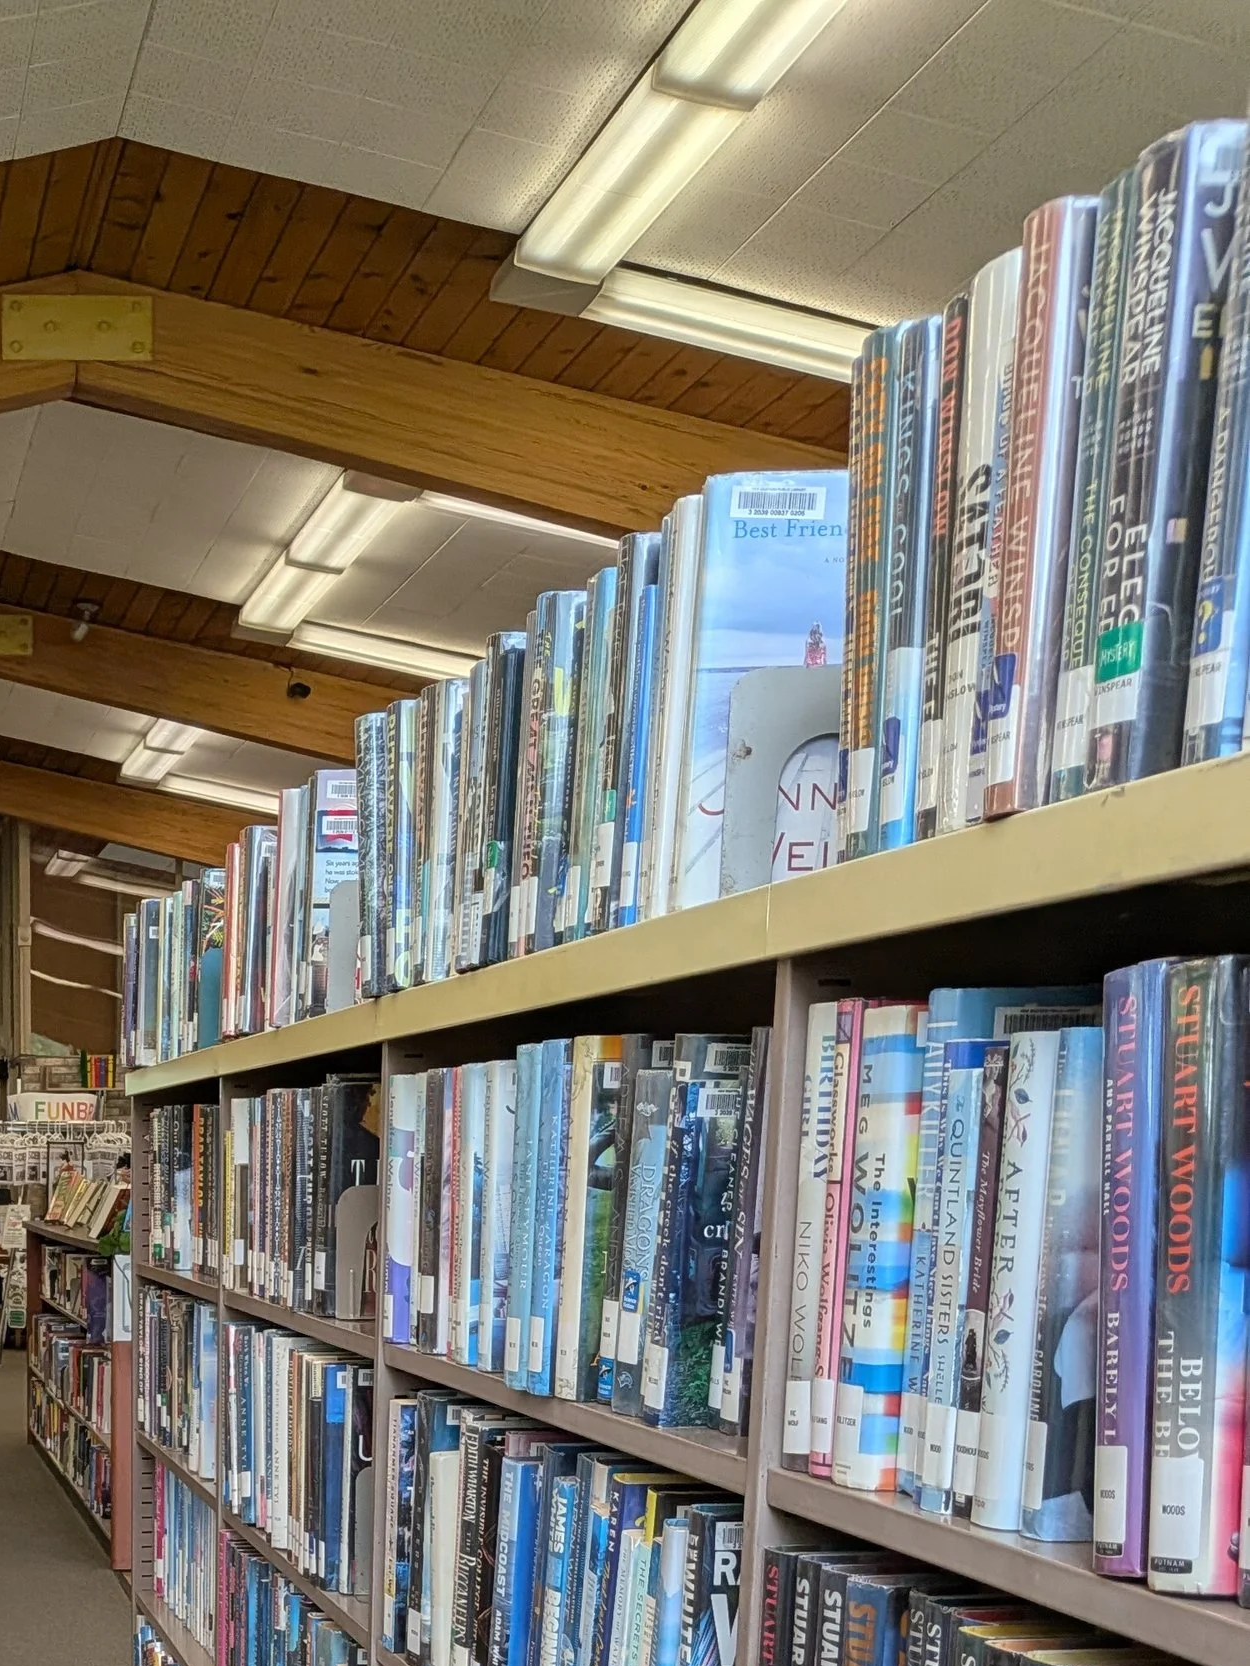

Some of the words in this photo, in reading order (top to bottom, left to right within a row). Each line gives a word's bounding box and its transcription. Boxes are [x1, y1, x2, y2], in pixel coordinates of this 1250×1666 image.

[1121, 191, 1158, 385] WINSPEAR
[1140, 188, 1178, 378] JACQUELINE
[1011, 243, 1049, 505] JACQUELINE
[734, 519, 777, 538] Best
[1104, 493, 1126, 578] FOR
[1115, 995, 1138, 1138] STUART
[1173, 984, 1200, 1134] STUART
[813, 1036, 836, 1178] BIRTHDAY
[827, 1051, 845, 1174] Glassworks
[859, 1064, 874, 1135] MEG
[873, 1153, 886, 1191] The
[941, 1119, 965, 1265] QUINTLAND
[980, 1152, 990, 1176] The
[1103, 1180, 1111, 1216] HALL
[637, 1164, 656, 1282] DRAGONS
[795, 1221, 813, 1290] NIKO
[976, 1181, 988, 1254] Mayflower
[997, 1160, 1023, 1274] AFTER
[1110, 1147, 1135, 1291] WOODS
[1167, 1146, 1196, 1294] WOODS
[863, 1201, 882, 1328] Interestings
[972, 1259, 984, 1294] Bride
[937, 1274, 953, 1344] SISTERS
[1104, 1311, 1120, 1419] BARELY
[1158, 1332, 1175, 1403] THE
[554, 1497, 568, 1553] JAMES
[608, 1491, 619, 1552] KAREN
[1161, 1506, 1185, 1516] WOODS
[496, 1510, 511, 1597] MIDCOAST
[637, 1559, 647, 1588] THE
[493, 1610, 502, 1637] ADAM
[631, 1590, 644, 1660] SECRETS
